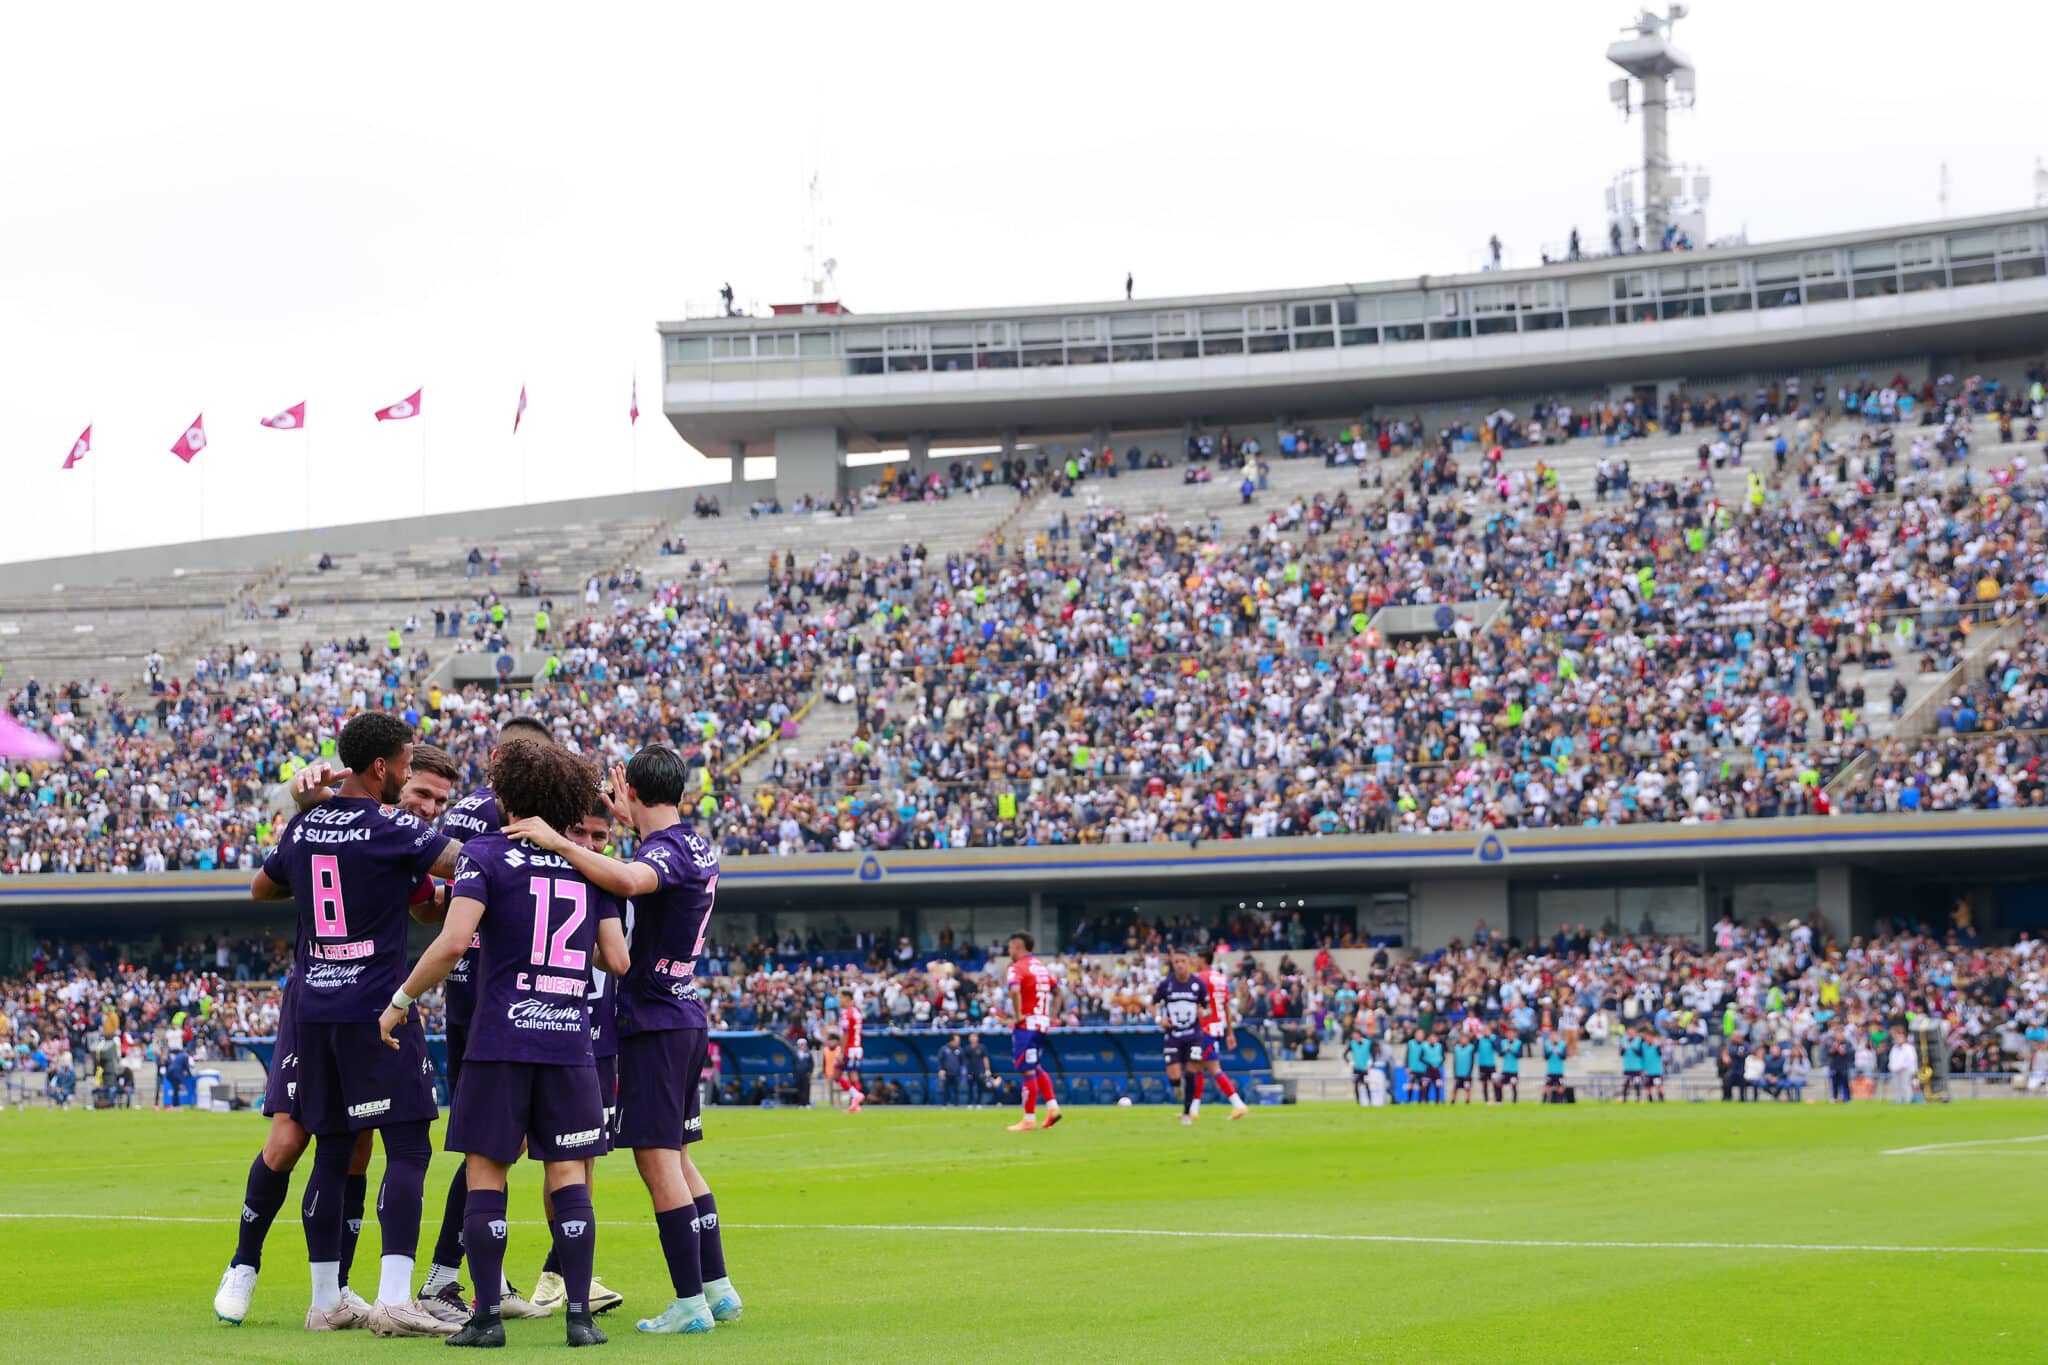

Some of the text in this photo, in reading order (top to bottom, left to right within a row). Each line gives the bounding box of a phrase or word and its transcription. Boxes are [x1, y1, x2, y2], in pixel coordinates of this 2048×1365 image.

[305, 828, 371, 843] SUZUKI
[311, 853, 348, 937] 8
[529, 875, 587, 970] 12
[516, 972, 532, 991] C.
[514, 1018, 582, 1033] caliente.mx
